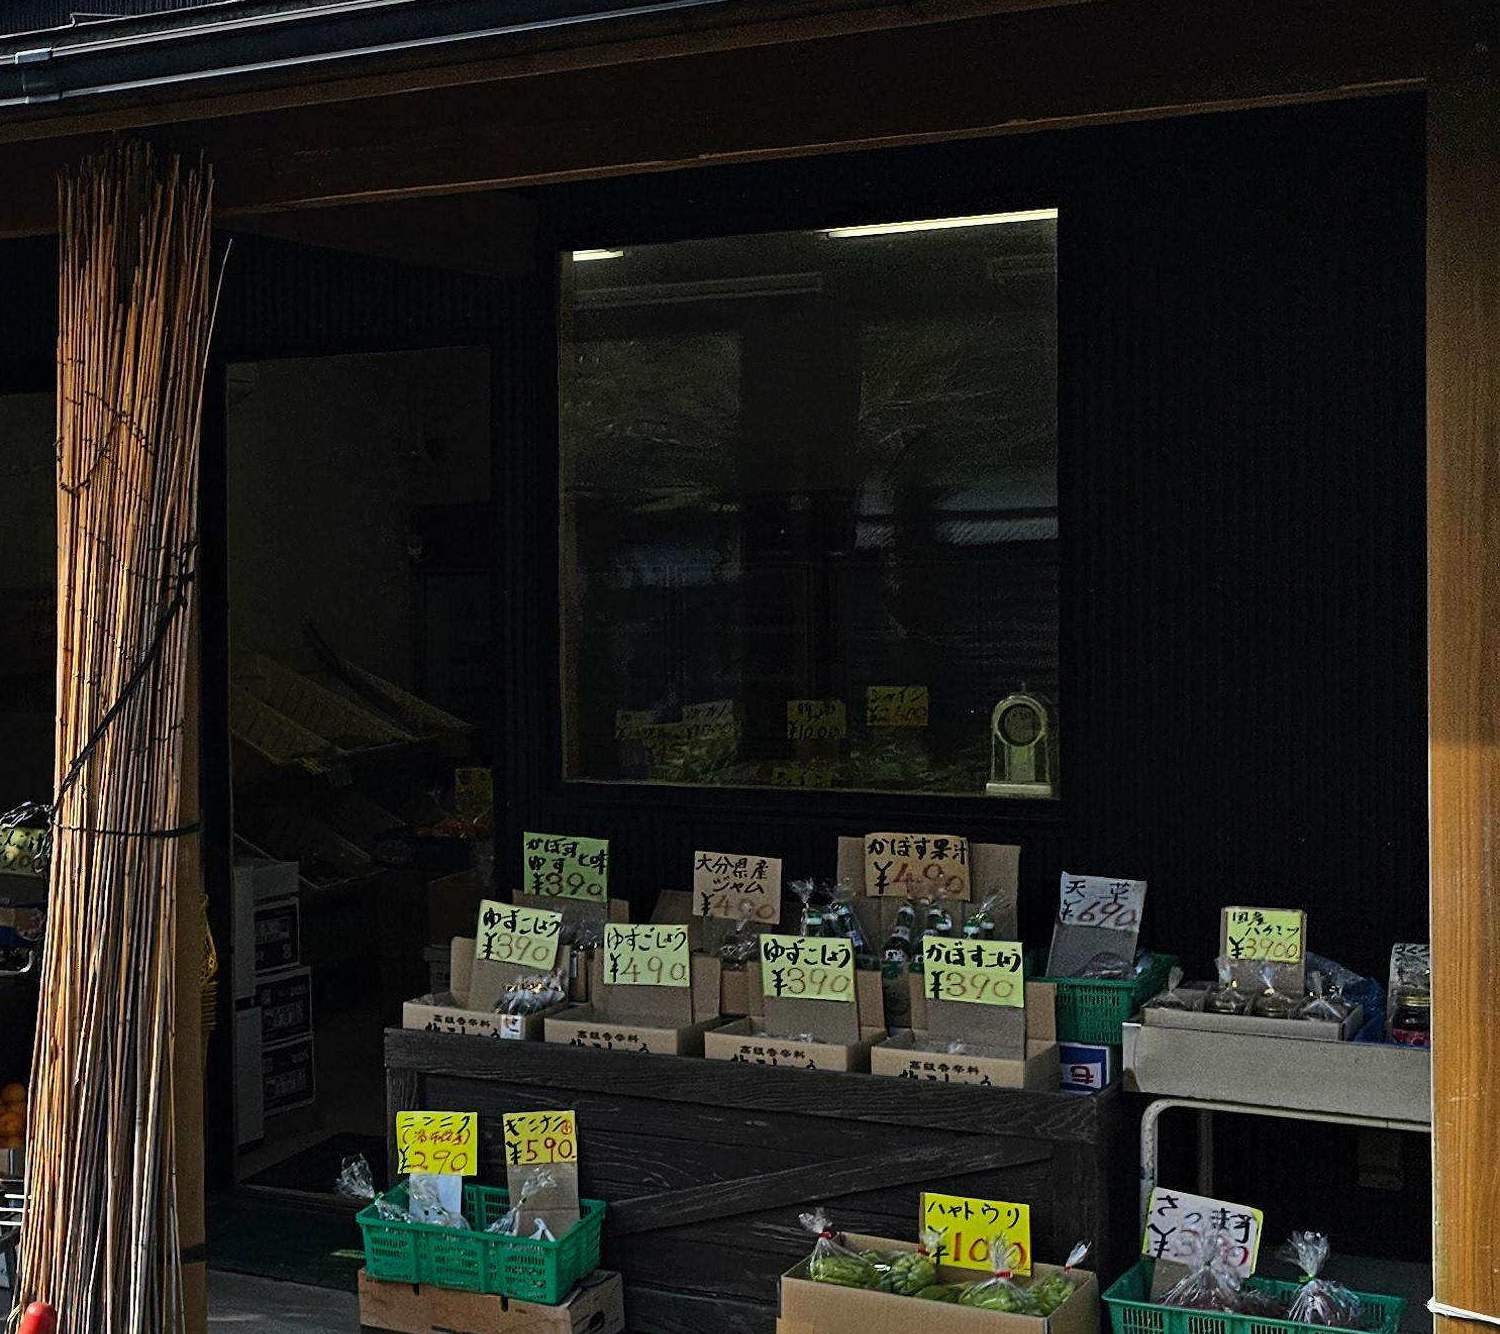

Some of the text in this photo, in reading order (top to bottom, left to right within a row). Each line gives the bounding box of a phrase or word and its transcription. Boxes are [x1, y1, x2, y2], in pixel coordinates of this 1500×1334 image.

[867, 835, 966, 865] かぼす果汁
[695, 853, 769, 880] 大分県産
[532, 872, 603, 897] ¥390
[712, 875, 764, 894] ジャム
[1060, 899, 1138, 927] ¥690
[482, 932, 550, 962] ¥390
[763, 938, 851, 968] ゆずこしょう
[771, 967, 850, 997] ¥390
[929, 970, 1014, 1000] ¥390
[401, 1115, 471, 1134] ニンニク
[399, 1145, 469, 1174] ¥290
